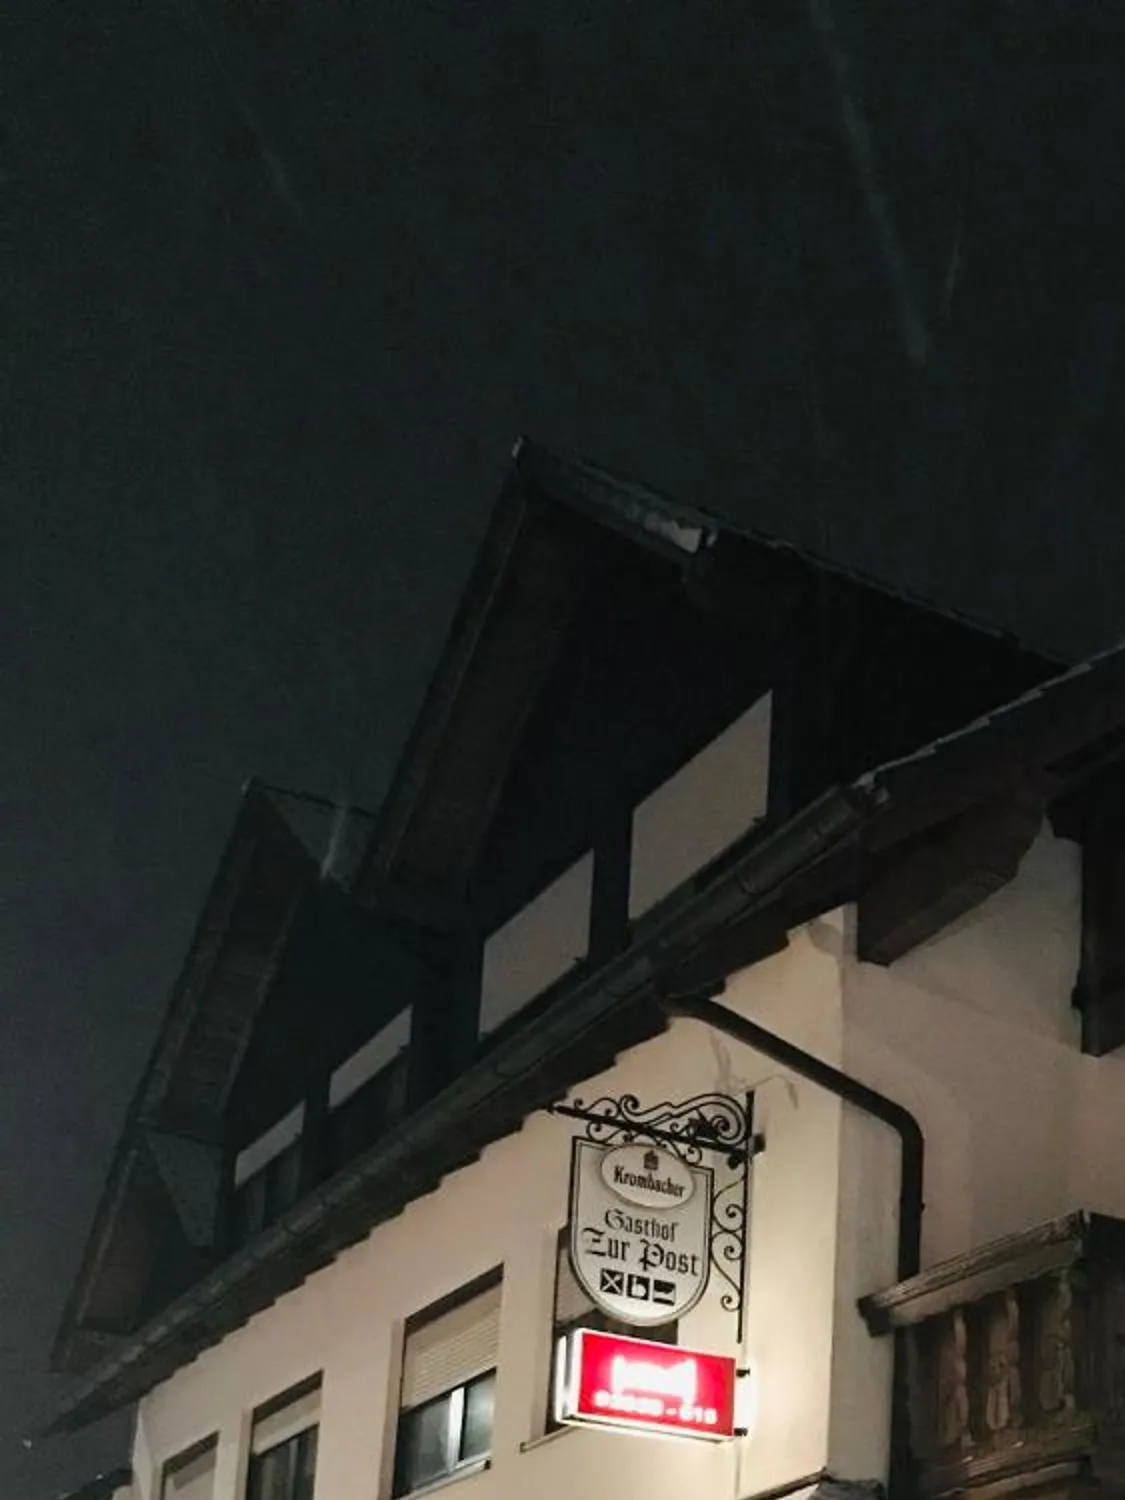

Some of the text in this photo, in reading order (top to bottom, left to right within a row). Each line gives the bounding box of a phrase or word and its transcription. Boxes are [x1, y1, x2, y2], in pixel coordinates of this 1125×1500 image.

[613, 1165, 686, 1197] Krombacher
[604, 1208, 678, 1242] Gasthof
[582, 1227, 700, 1276] Zur Post
